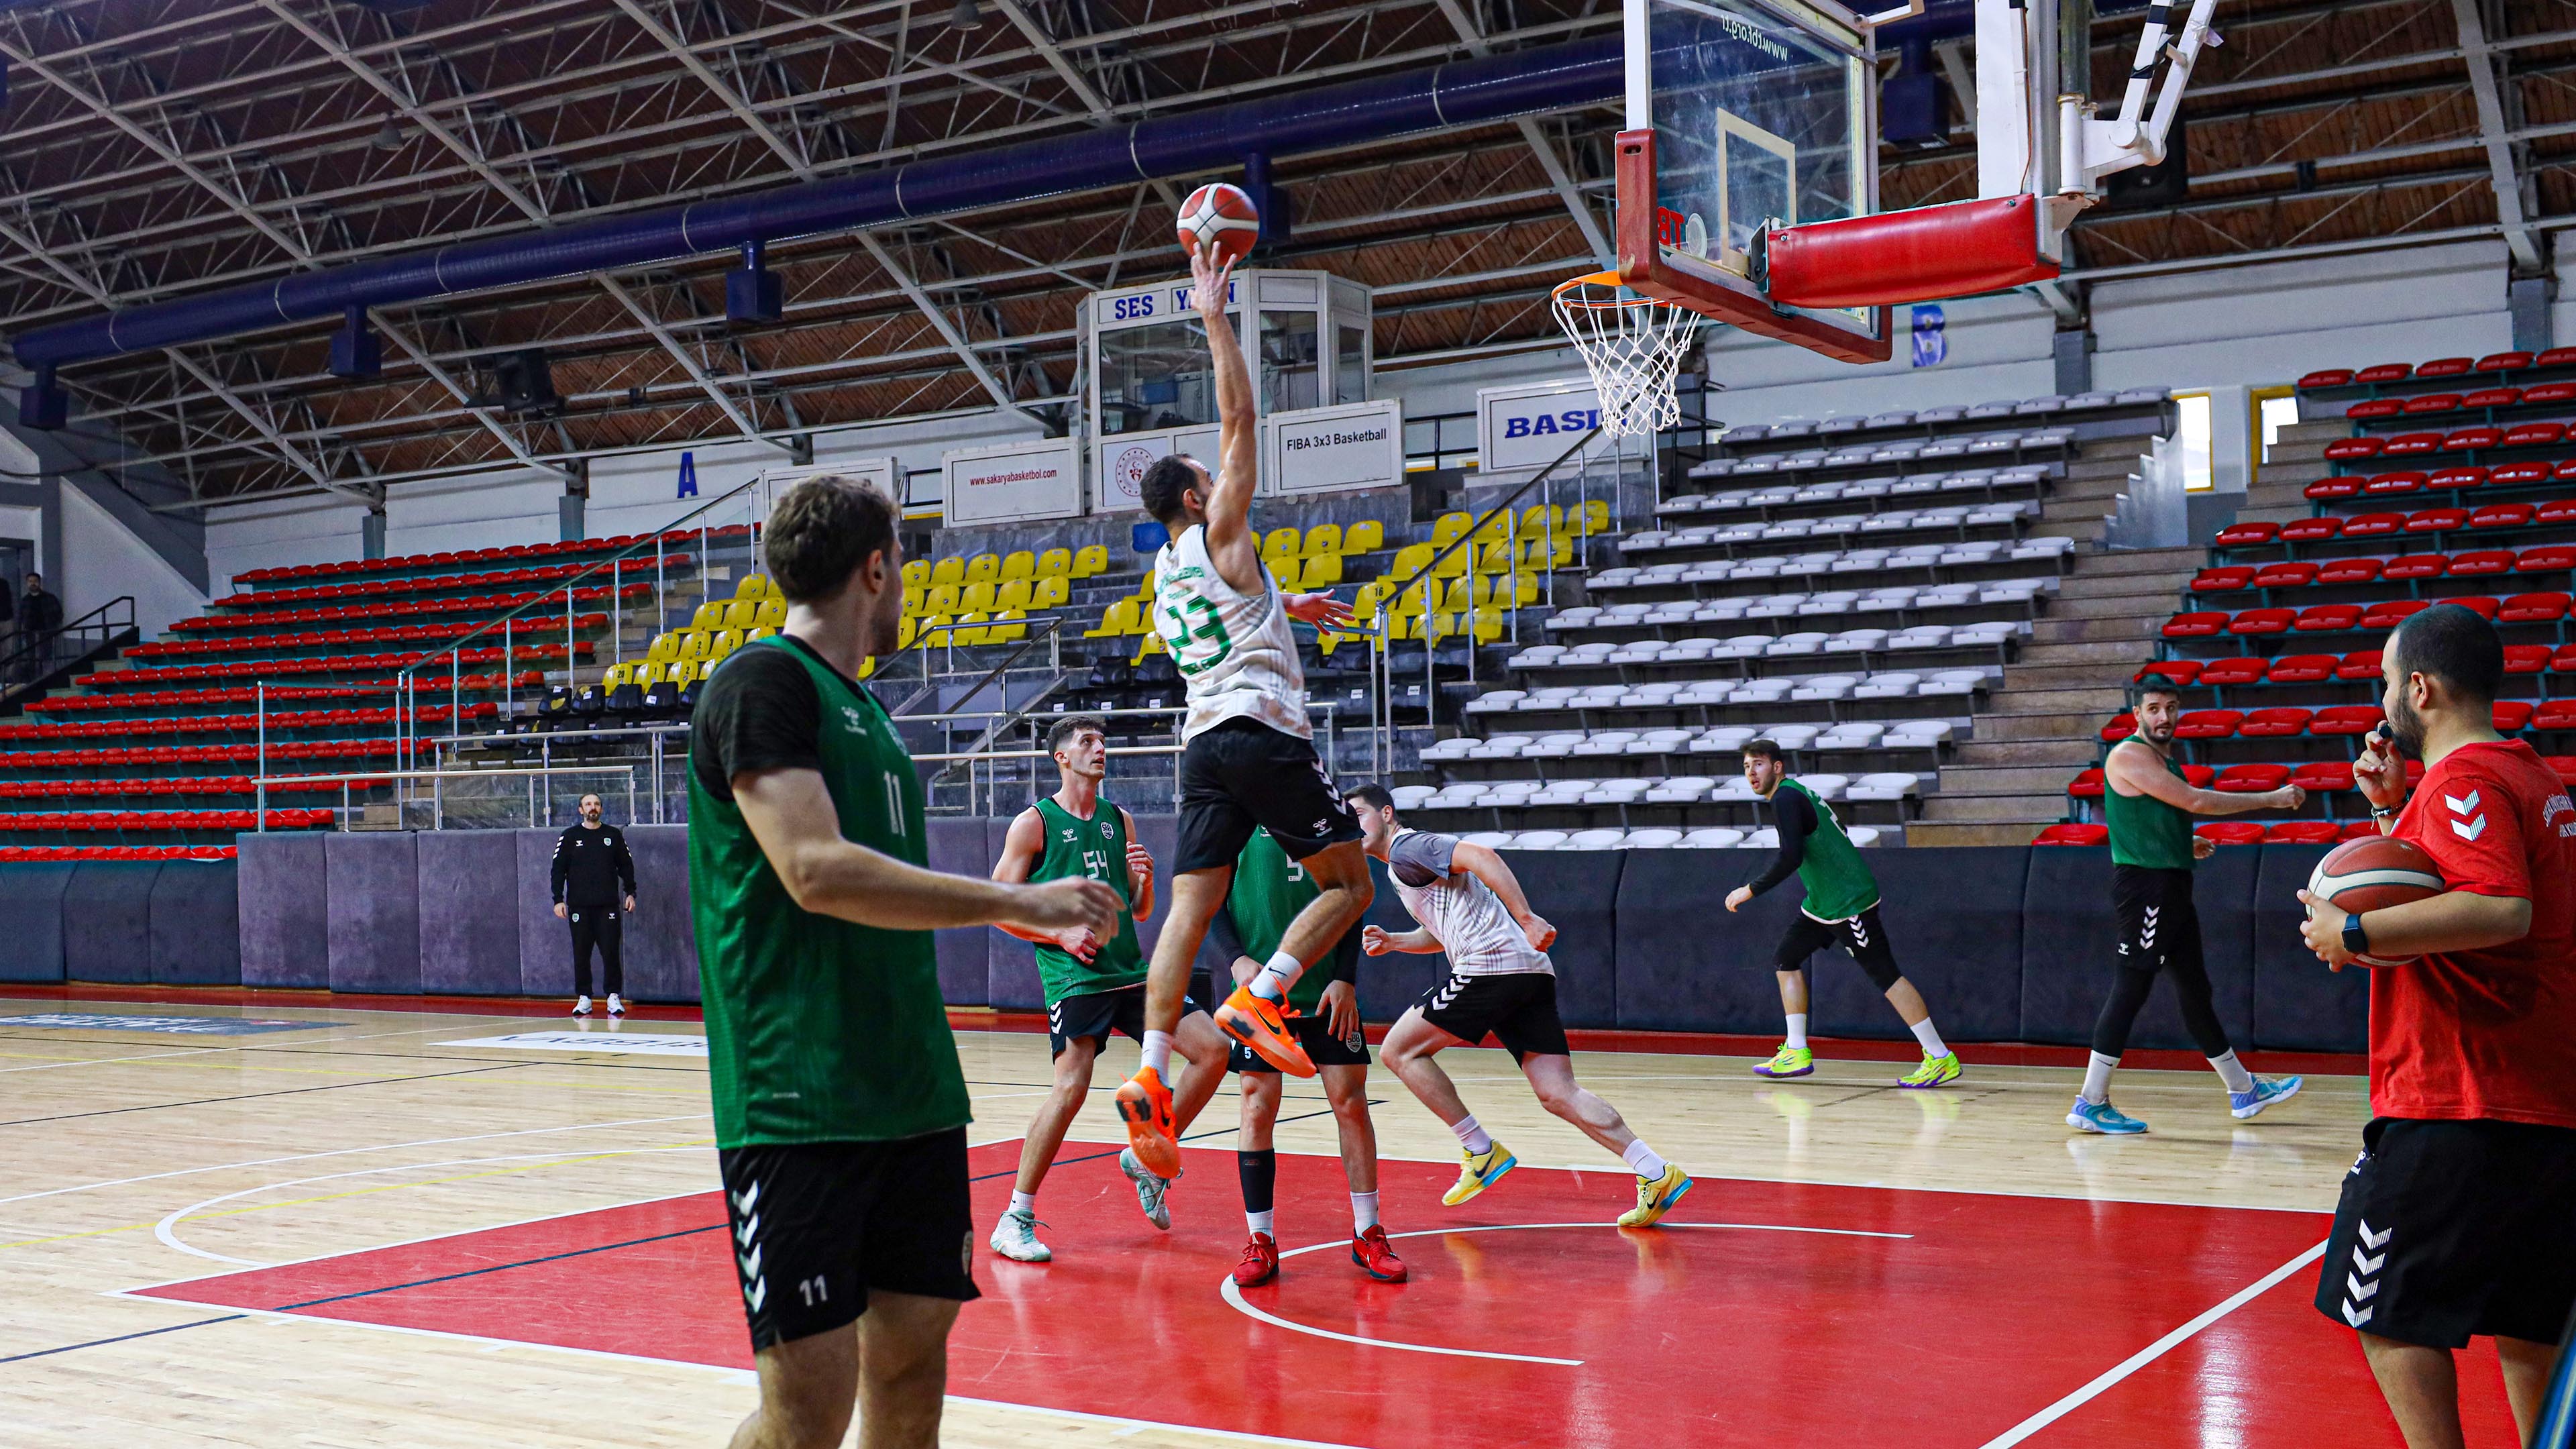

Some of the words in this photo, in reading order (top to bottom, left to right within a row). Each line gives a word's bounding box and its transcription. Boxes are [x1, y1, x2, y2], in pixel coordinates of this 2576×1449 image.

[1115, 295, 1153, 319] SES
[1913, 305, 1947, 368] B
[1287, 437, 1311, 451] FIBA
[1313, 435, 1331, 447] 3x3
[1334, 428, 1387, 445] Basketball
[678, 451, 698, 498] A
[970, 469, 1057, 486] www.sakaryabasketbol.com
[1375, 587, 1383, 596] 16
[729, 639, 733, 647] 3
[1166, 595, 1231, 676] 23
[618, 670, 625, 678] 20
[686, 666, 690, 674] 2
[884, 771, 905, 837] 11
[1083, 850, 1110, 879] 54
[1244, 1047, 1251, 1059] 5
[799, 1275, 828, 1306] 11
